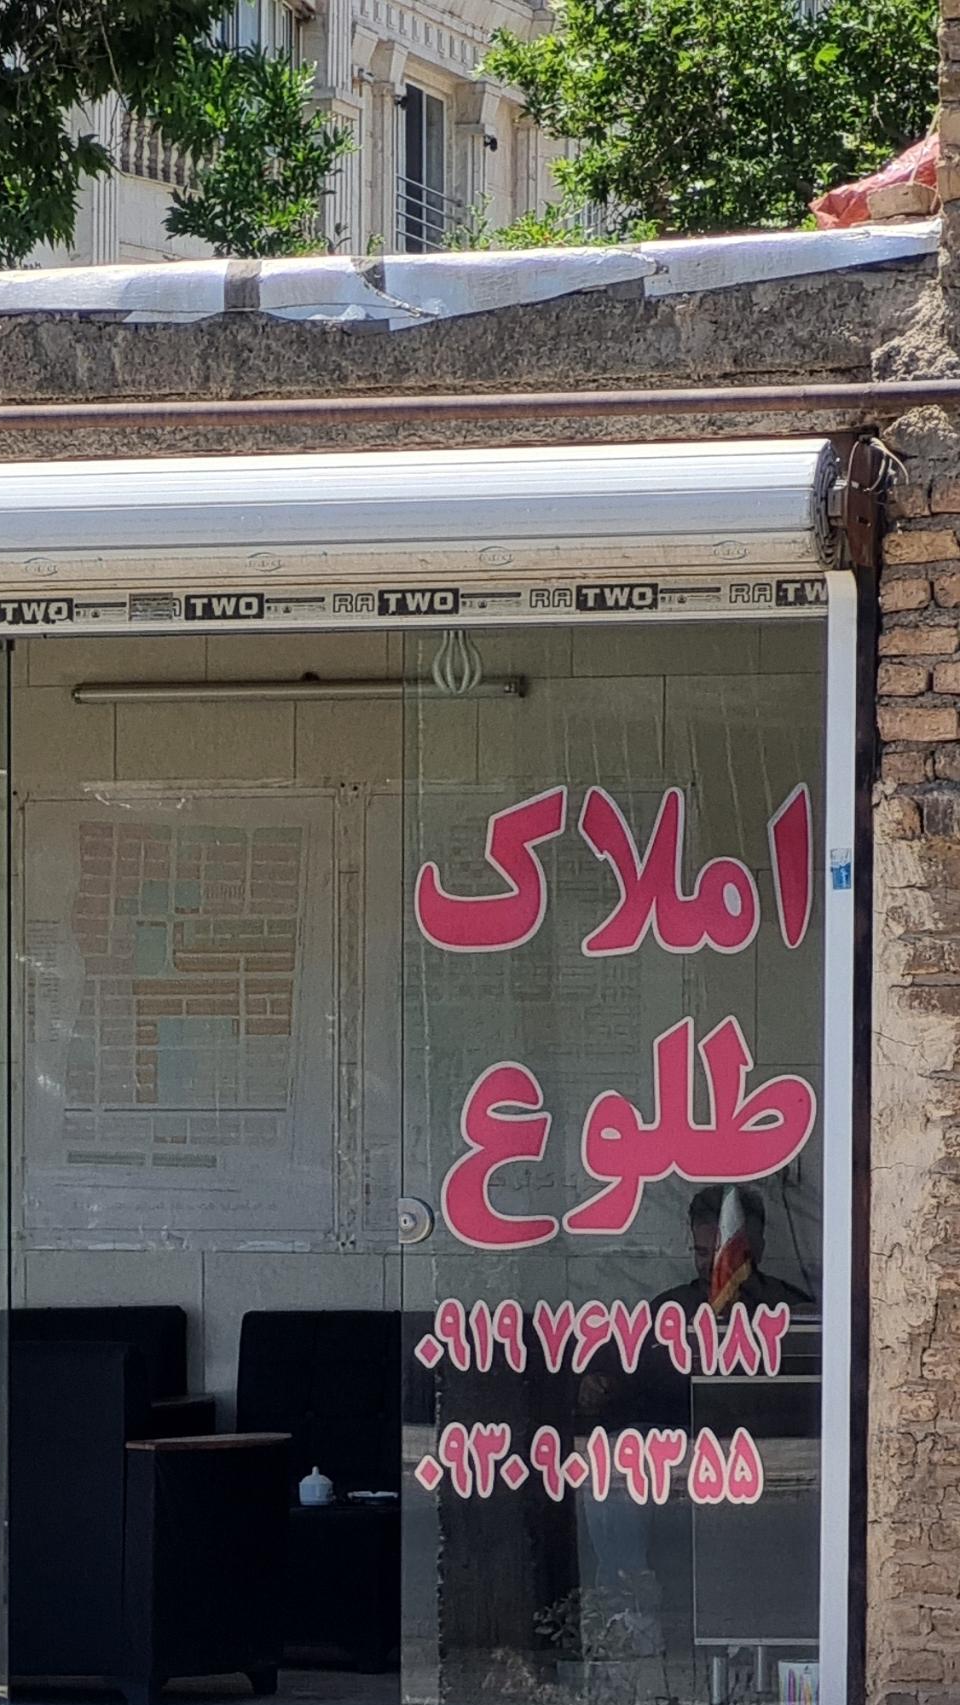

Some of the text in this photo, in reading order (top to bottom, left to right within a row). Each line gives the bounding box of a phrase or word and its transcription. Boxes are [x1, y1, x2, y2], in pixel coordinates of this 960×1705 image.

[385, 591, 454, 614] TWO
[581, 587, 654, 609] TWO
[786, 581, 828, 603] TW
[0, 601, 70, 624] TWO
[189, 596, 259, 618] TWO
[415, 783, 812, 956] املاک
[441, 1017, 816, 1249] طلوع
[414, 1421, 764, 1505] ۰۹۳۰۹۰۱۹۳۵۵
